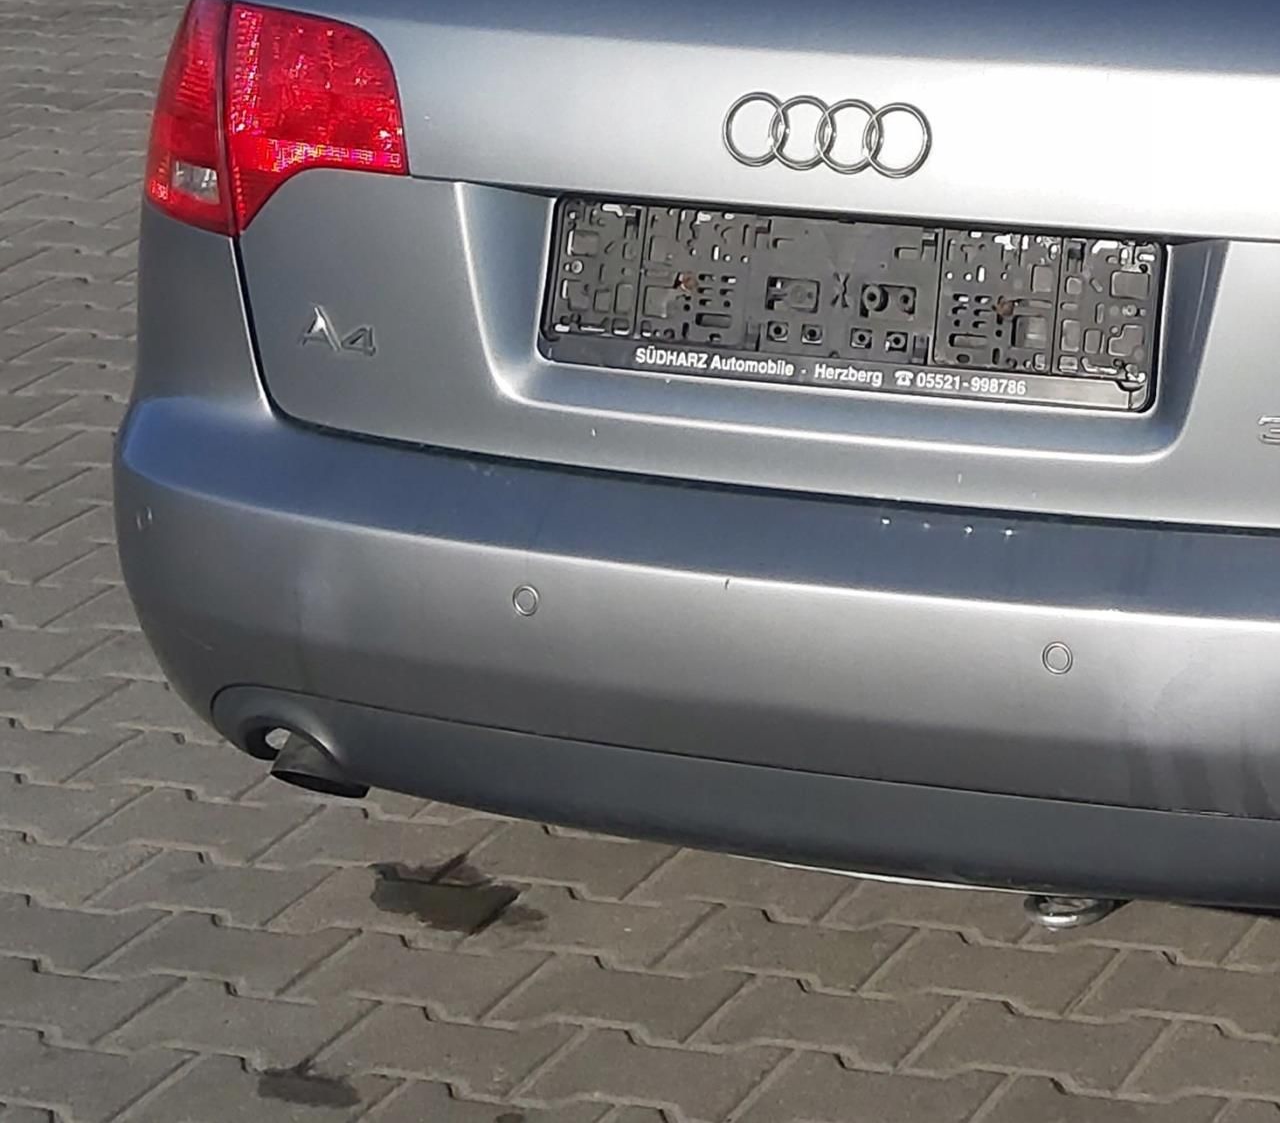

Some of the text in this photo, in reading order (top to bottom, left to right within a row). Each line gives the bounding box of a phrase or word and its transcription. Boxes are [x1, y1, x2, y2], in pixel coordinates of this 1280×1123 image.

[302, 305, 377, 356] A4
[635, 345, 1027, 395] SÜDHARZ Automobile Herzberg 05521-998786
